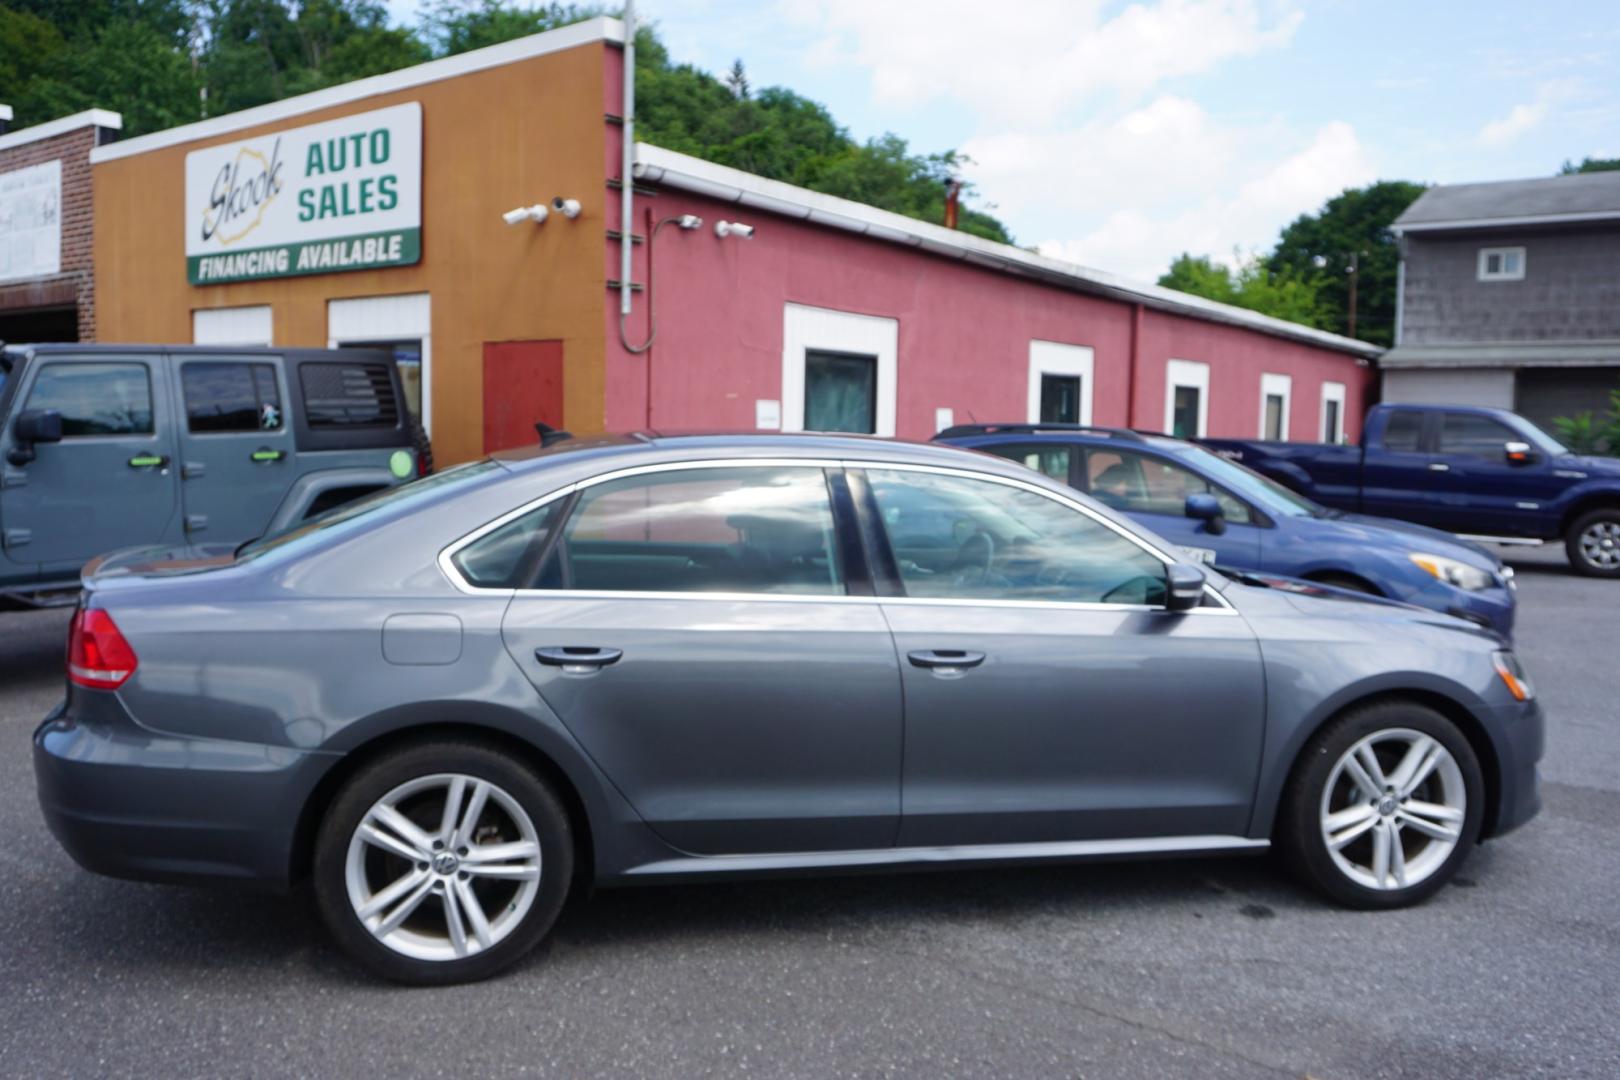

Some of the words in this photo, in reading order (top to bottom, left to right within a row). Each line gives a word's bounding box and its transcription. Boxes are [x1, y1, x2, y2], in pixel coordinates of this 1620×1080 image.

[305, 128, 390, 177] AUTO
[202, 136, 283, 242] Skook
[297, 175, 398, 222] SALES
[198, 248, 290, 281] FINANCING
[296, 234, 403, 270] AVAILABLE
